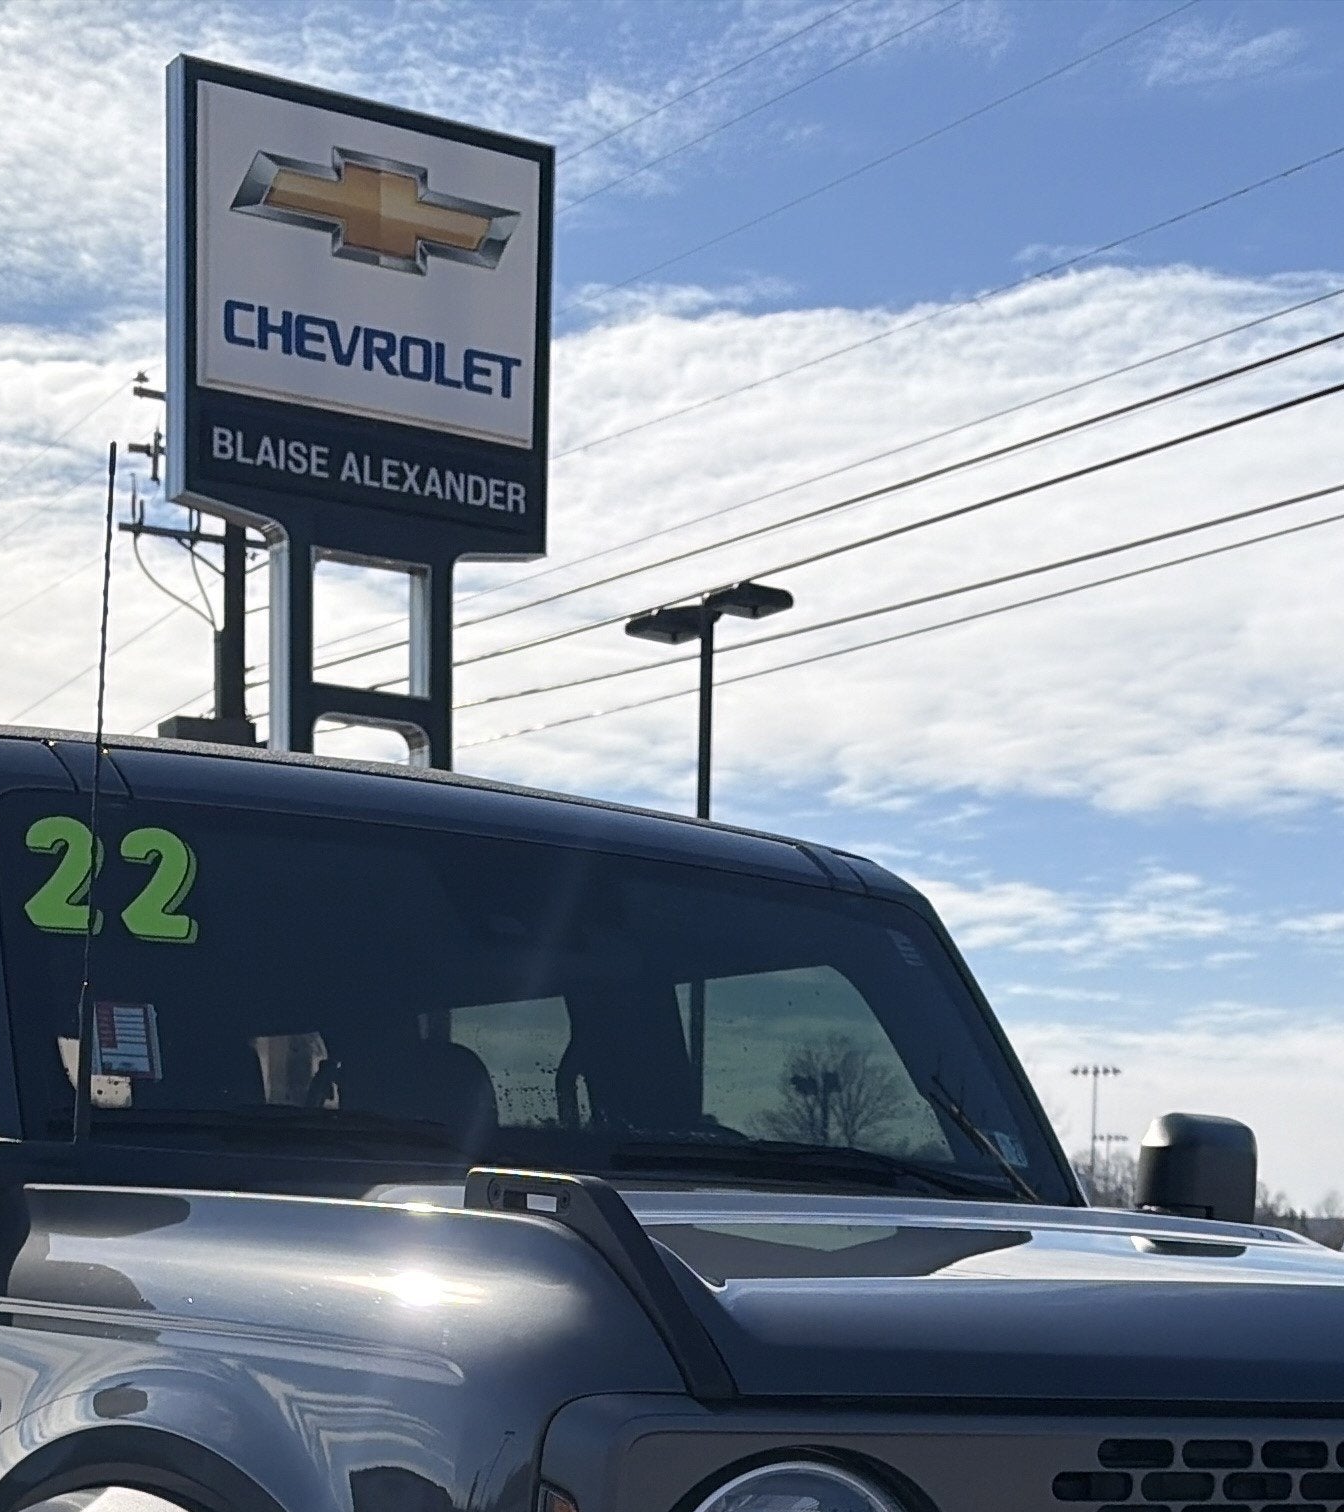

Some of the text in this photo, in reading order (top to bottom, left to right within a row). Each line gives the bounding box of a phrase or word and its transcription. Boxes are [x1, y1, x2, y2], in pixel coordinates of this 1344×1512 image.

[223, 298, 523, 400] CHEVROLET
[211, 425, 527, 515] BLAISE ALEXANDER
[23, 815, 199, 944] 22
